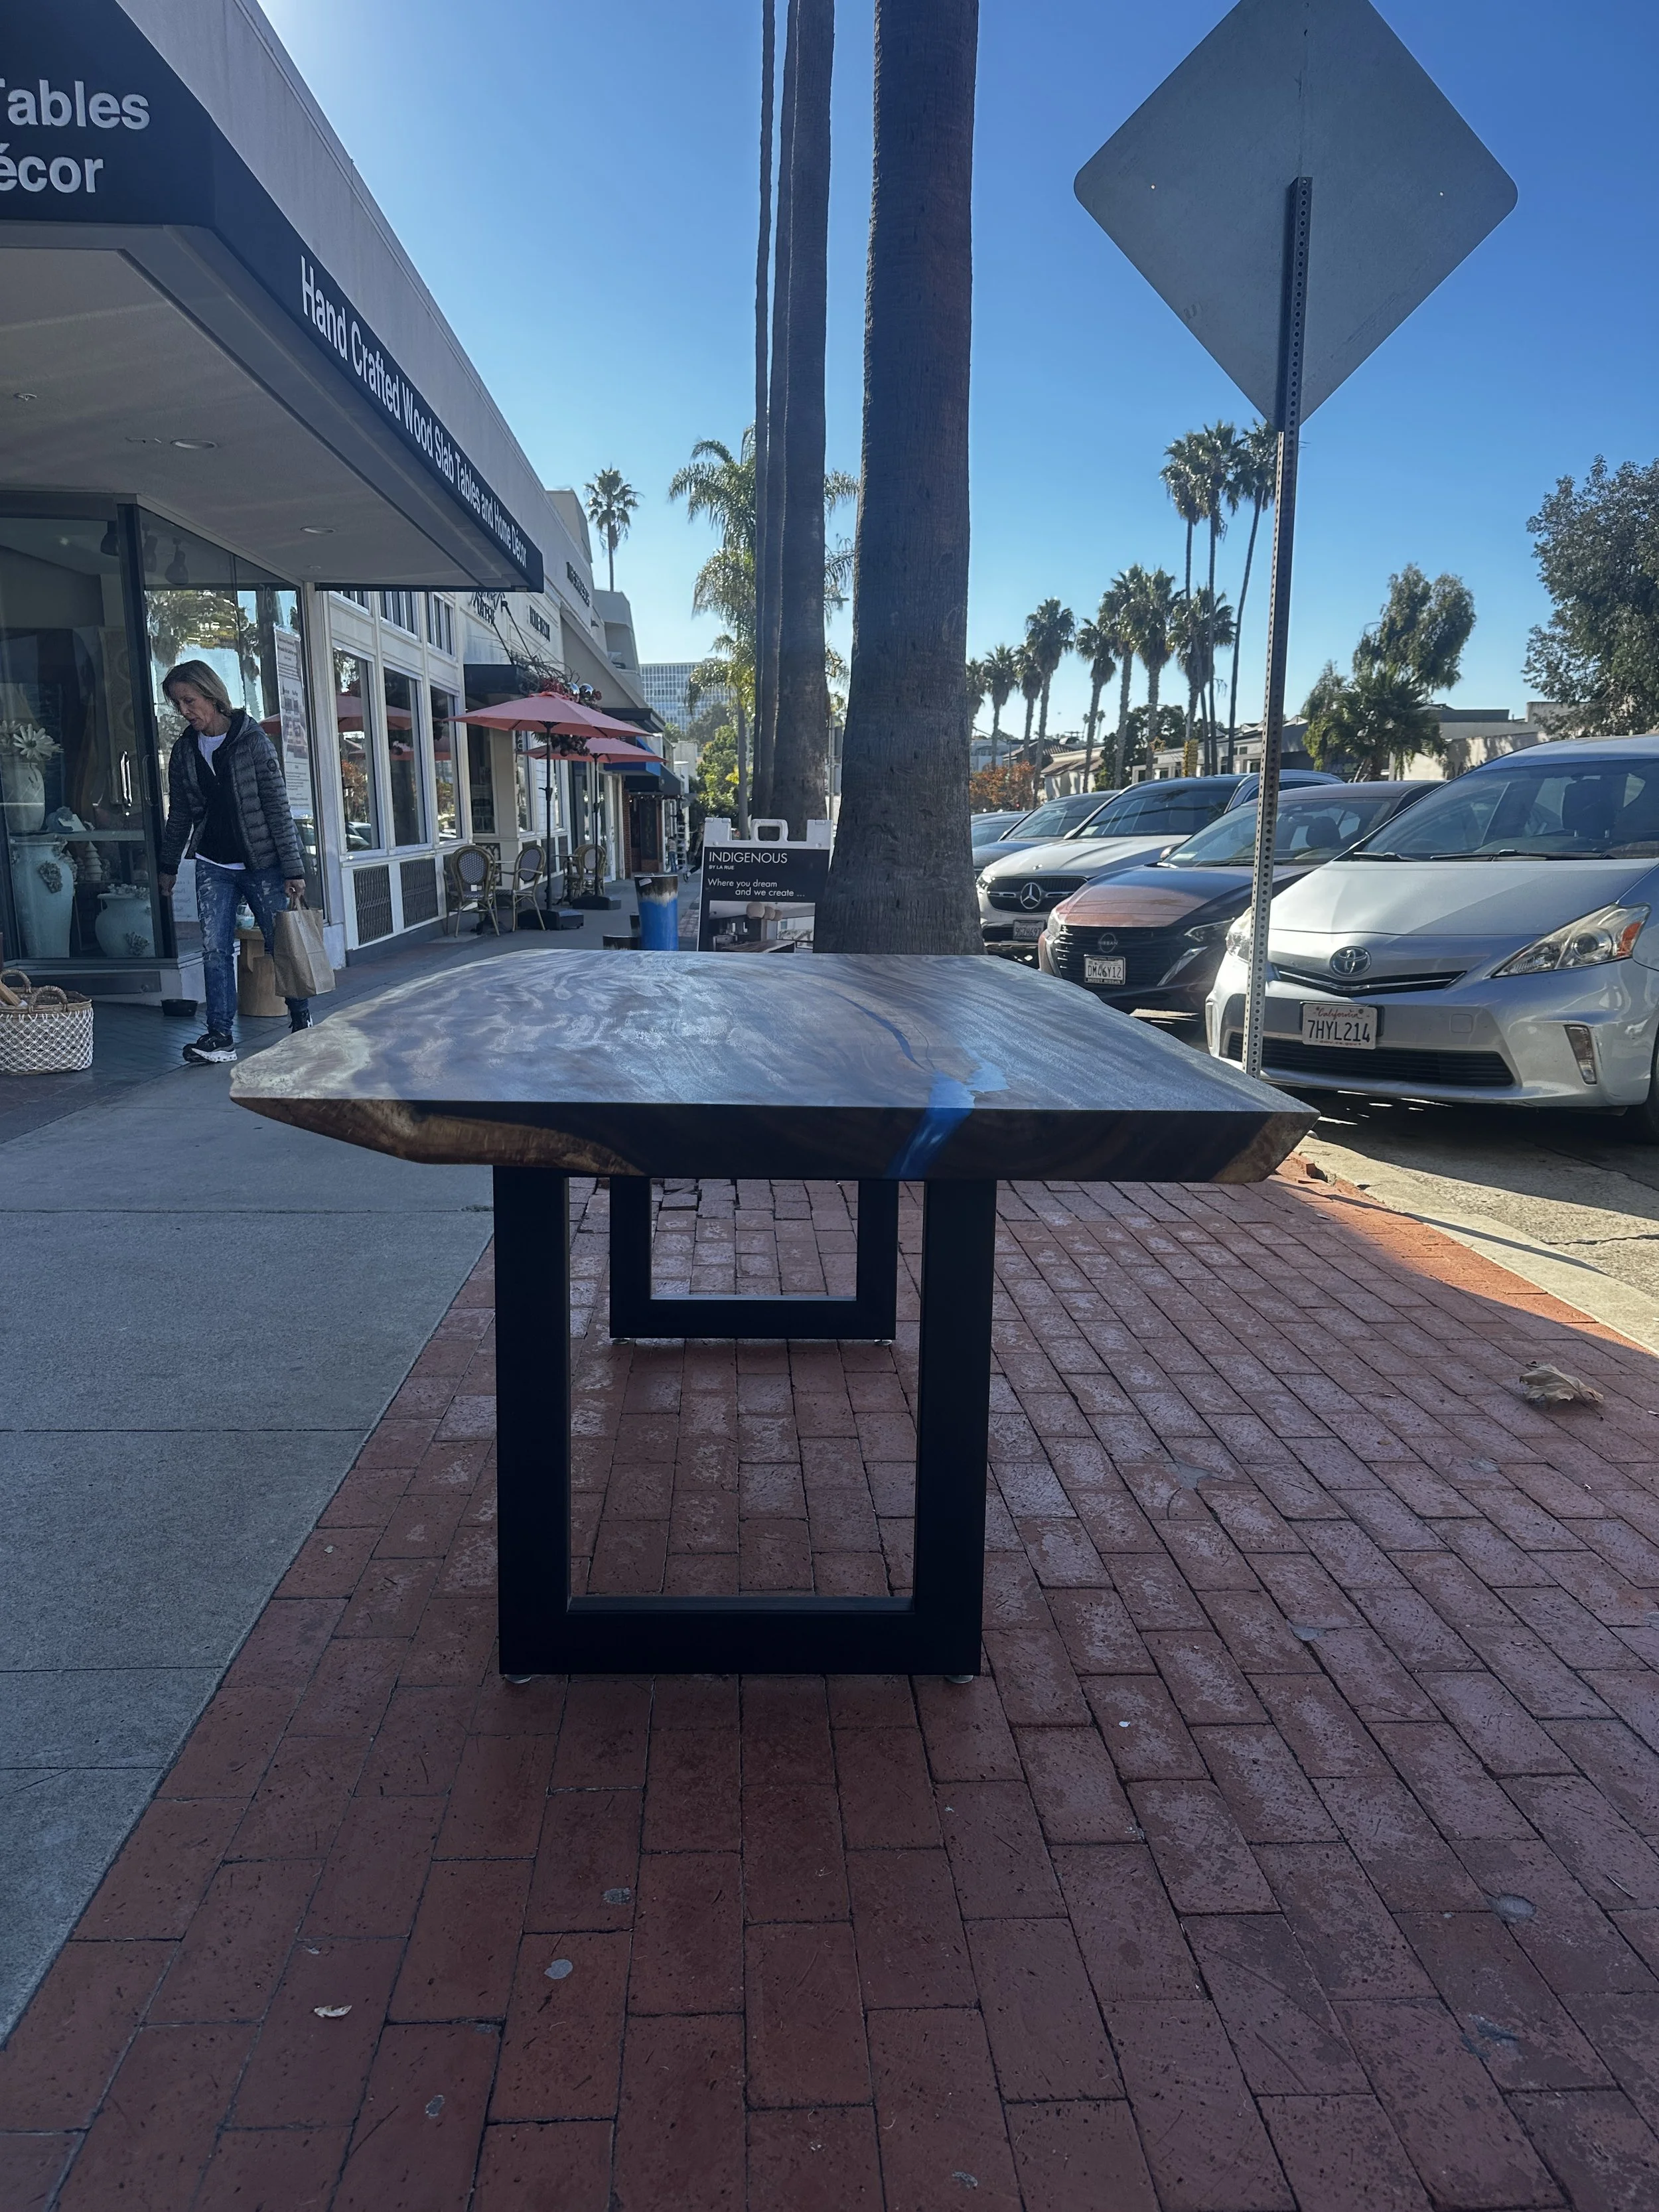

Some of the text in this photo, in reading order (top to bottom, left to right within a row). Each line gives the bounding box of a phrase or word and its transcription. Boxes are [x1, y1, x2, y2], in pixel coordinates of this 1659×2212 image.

[0, 78, 150, 130] ables
[301, 255, 527, 568] Hand Crafted Wood Slab Tables and Home Décor
[709, 851, 788, 863] INDIGENOUS
[707, 878, 778, 889] Where you dream
[735, 887, 751, 896] and
[1088, 964, 1121, 979] DM46Y12
[1317, 1007, 1362, 1020] California
[1307, 1019, 1370, 1043] 7HYL214
